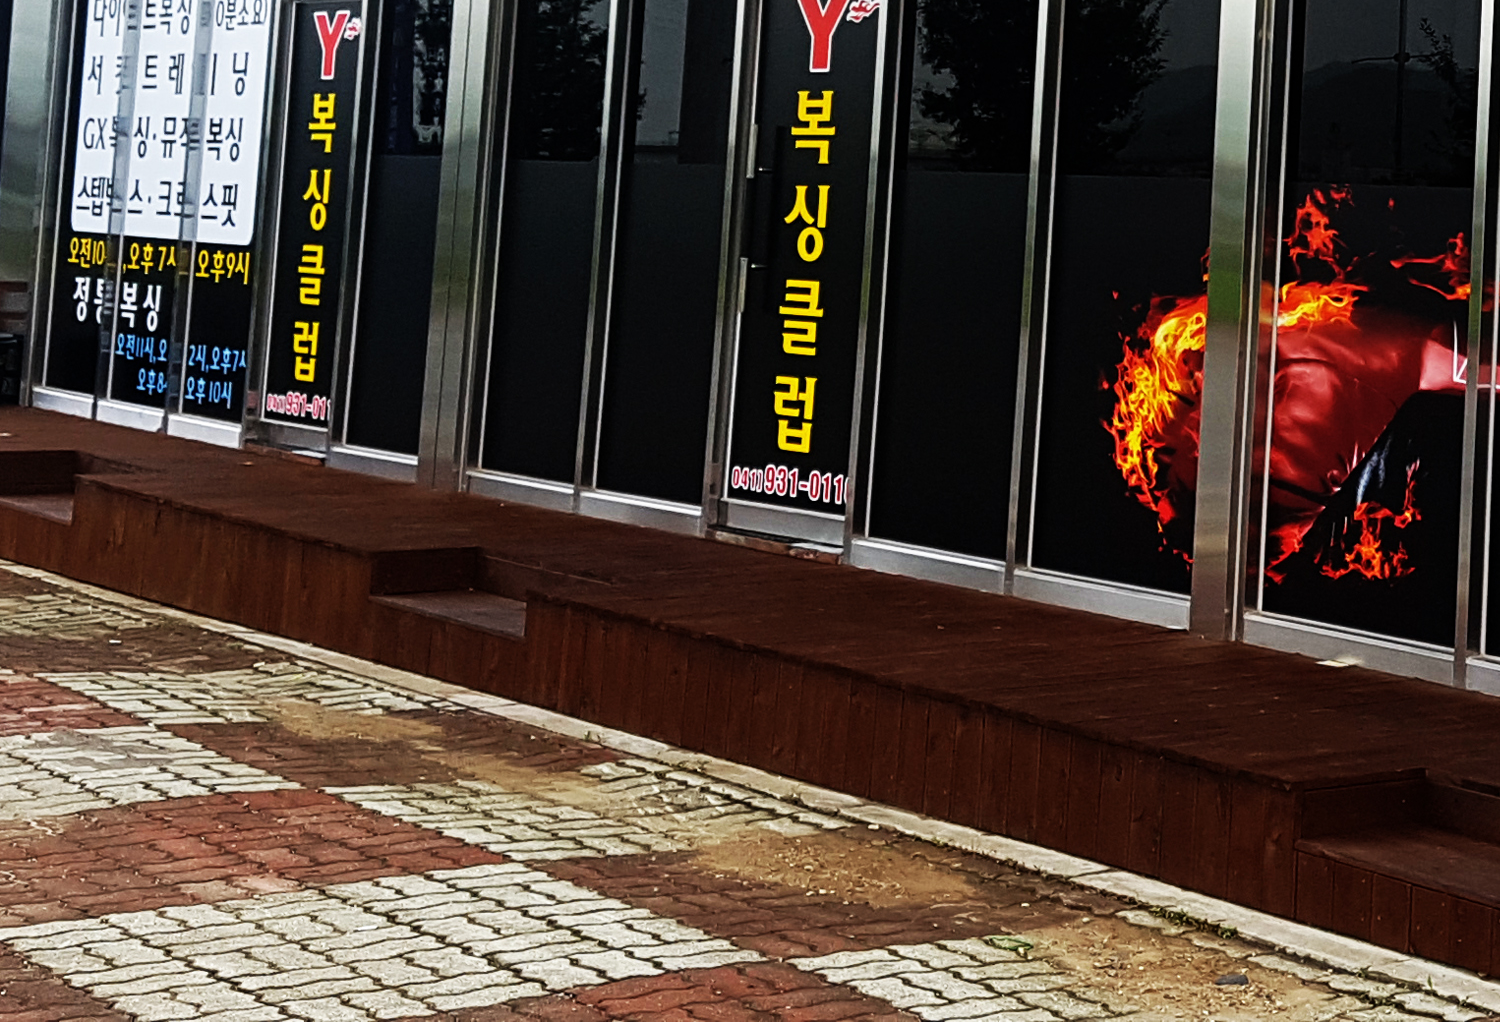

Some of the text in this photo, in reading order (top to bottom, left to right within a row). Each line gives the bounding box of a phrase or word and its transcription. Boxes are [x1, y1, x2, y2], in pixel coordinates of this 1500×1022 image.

[313, 9, 351, 80] Y
[293, 93, 337, 383] 복싱클럽
[773, 90, 836, 454] 복싱클럽
[731, 463, 850, 505] 041)931-011
